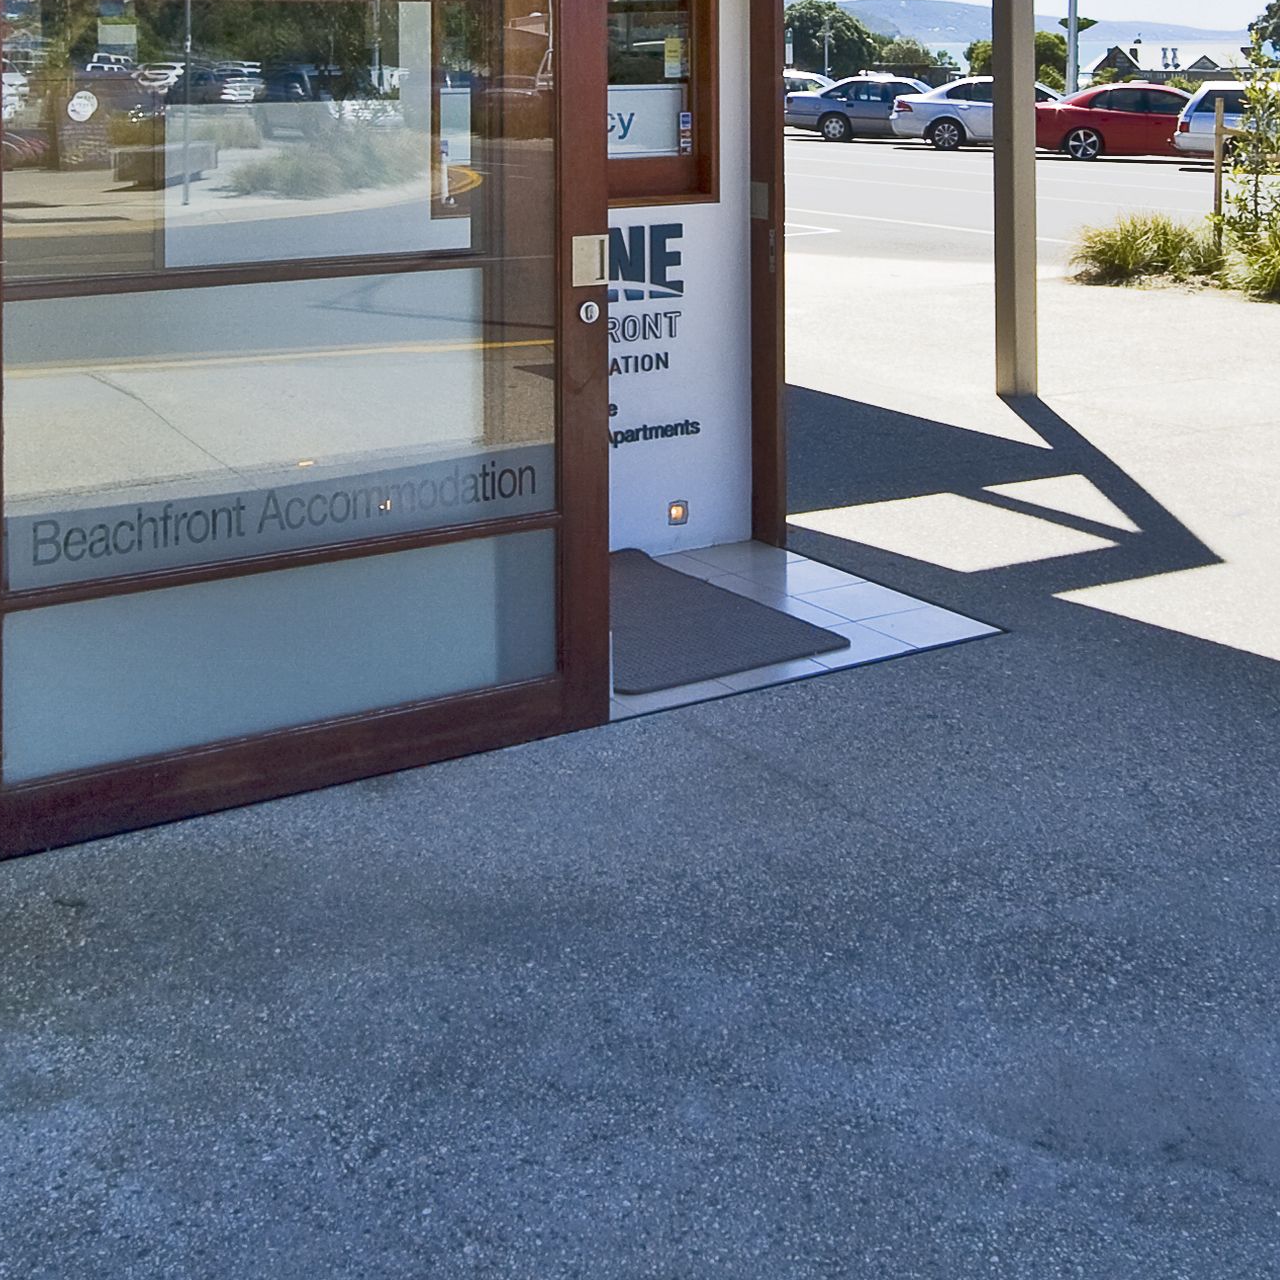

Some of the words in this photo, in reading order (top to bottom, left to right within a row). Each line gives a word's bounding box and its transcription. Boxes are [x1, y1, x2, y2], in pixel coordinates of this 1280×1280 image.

[609, 419, 701, 448] partments
[32, 496, 246, 567] Beachfront
[256, 460, 537, 534] Accommodation
